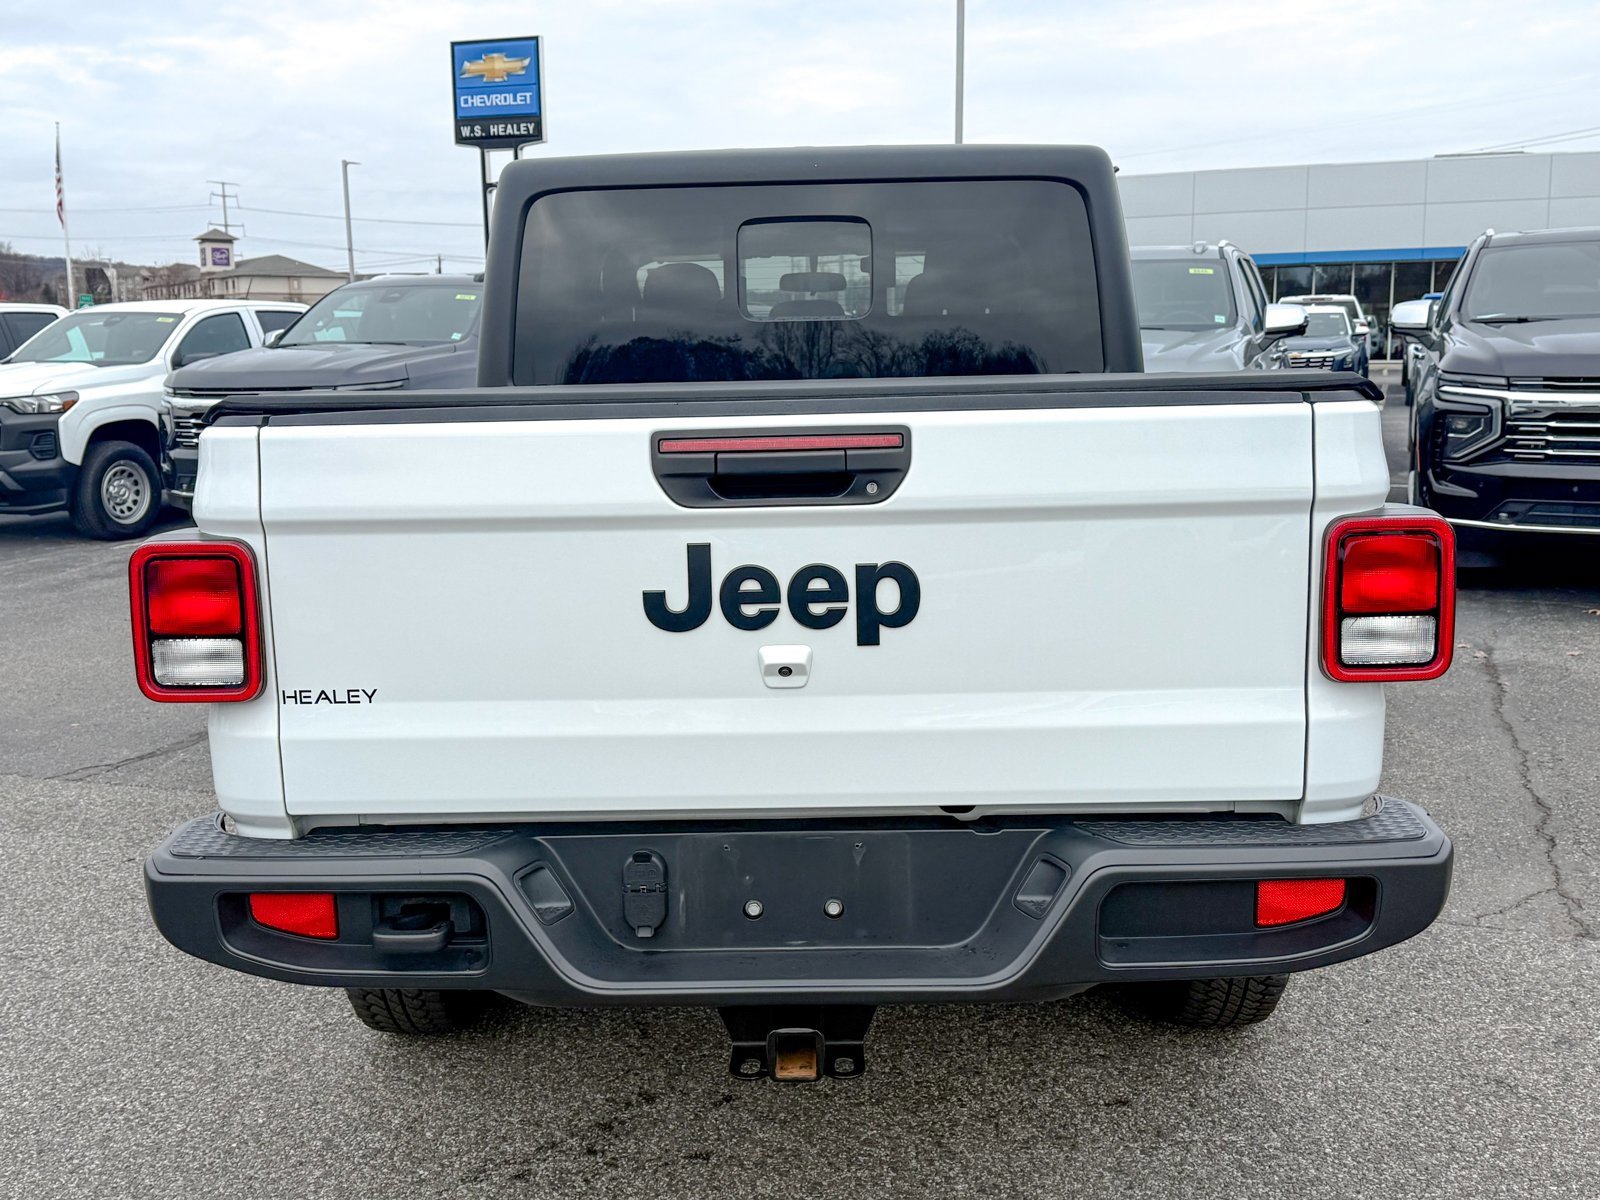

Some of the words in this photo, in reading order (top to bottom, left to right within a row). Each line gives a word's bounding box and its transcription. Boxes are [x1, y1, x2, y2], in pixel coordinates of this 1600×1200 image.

[461, 93, 532, 107] CHEVROLET
[461, 126, 485, 137] W.S.
[491, 123, 535, 135] HEALEY
[642, 543, 921, 646] Jeep
[283, 690, 377, 704] HEALEY
